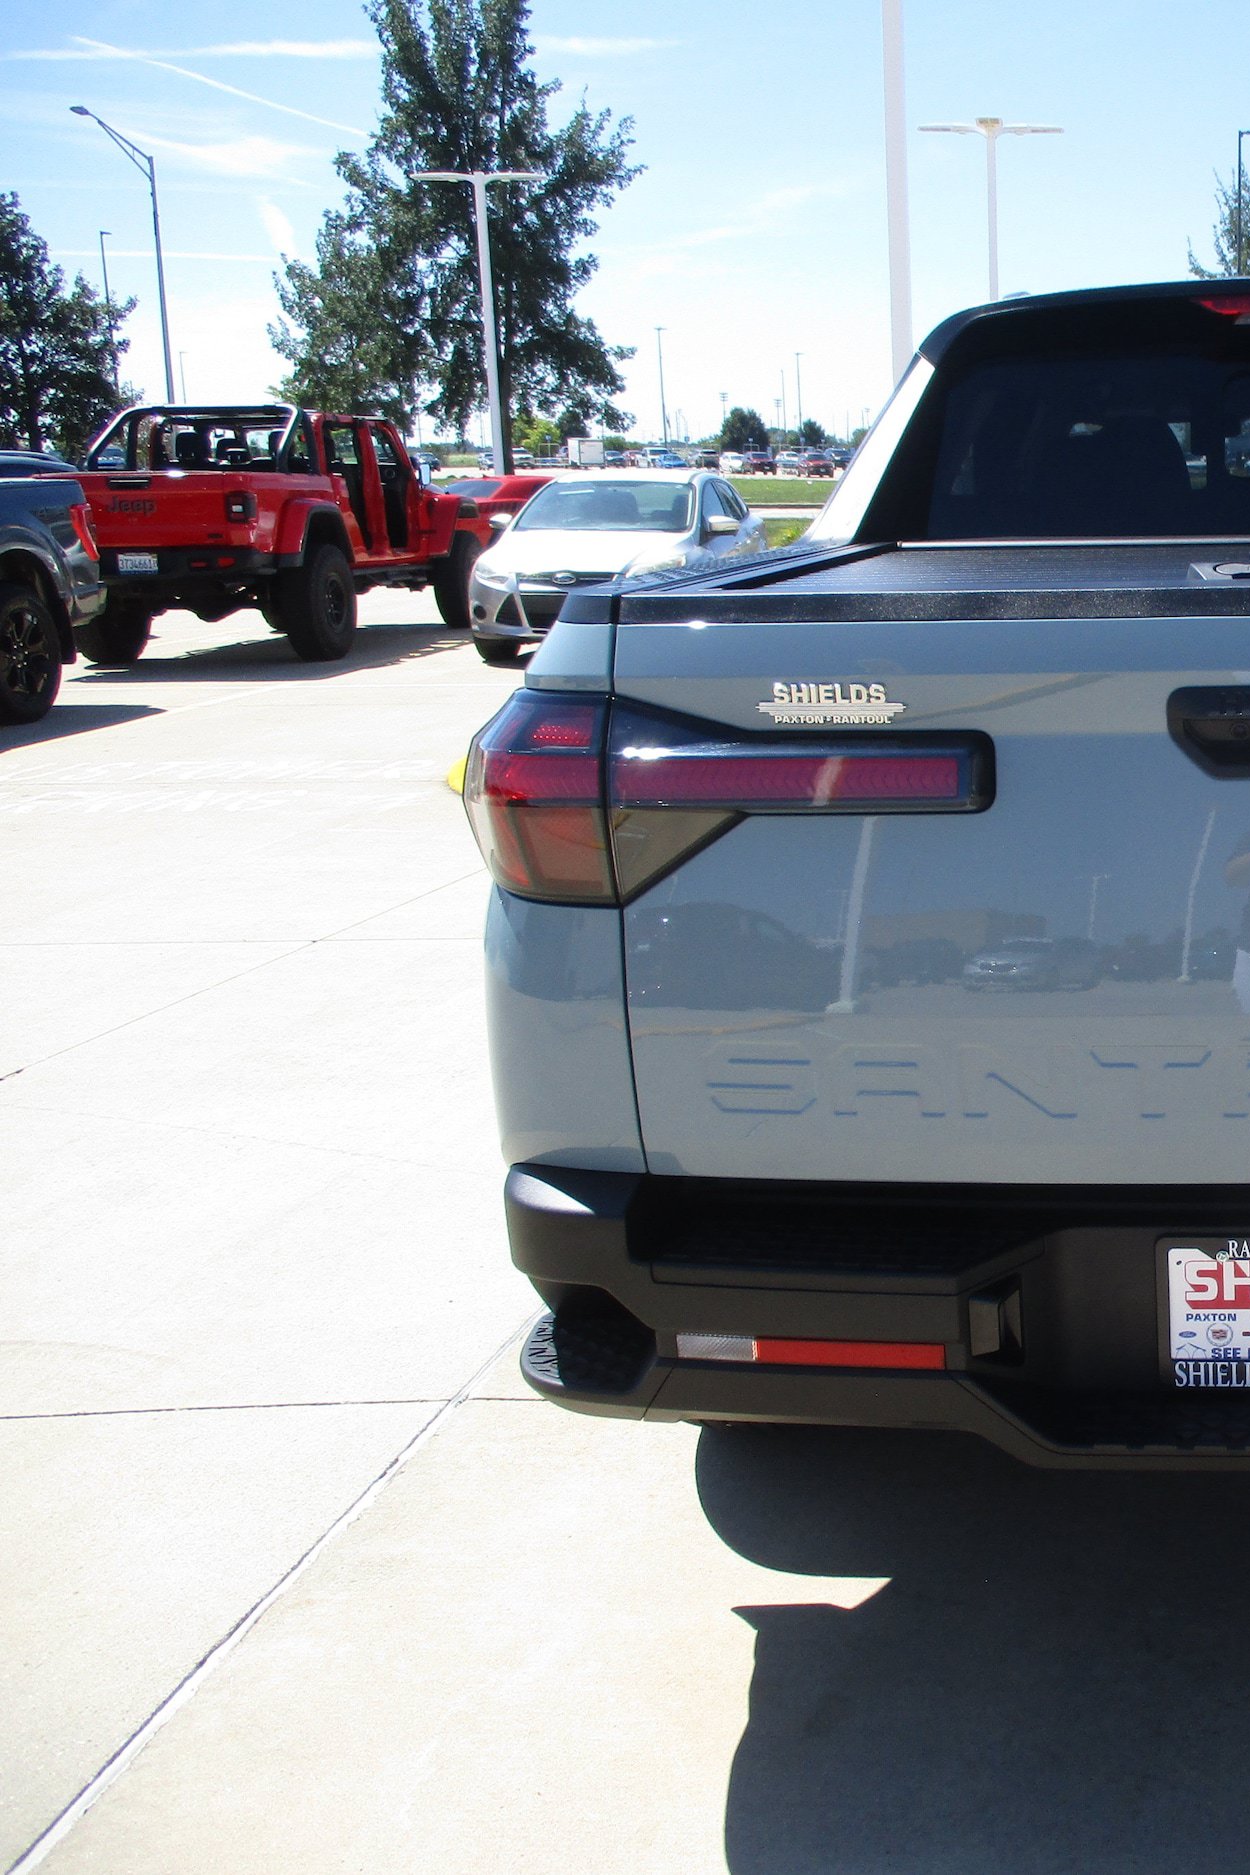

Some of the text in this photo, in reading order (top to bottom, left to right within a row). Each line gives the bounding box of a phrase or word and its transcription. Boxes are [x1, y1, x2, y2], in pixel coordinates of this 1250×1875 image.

[107, 496, 156, 515] Jeep
[772, 682, 887, 704] SHIELDS
[774, 715, 892, 724] PAXTON RANTOUL
[1186, 1313, 1237, 1322] PAXTON
[1211, 1347, 1242, 1360] SEE
